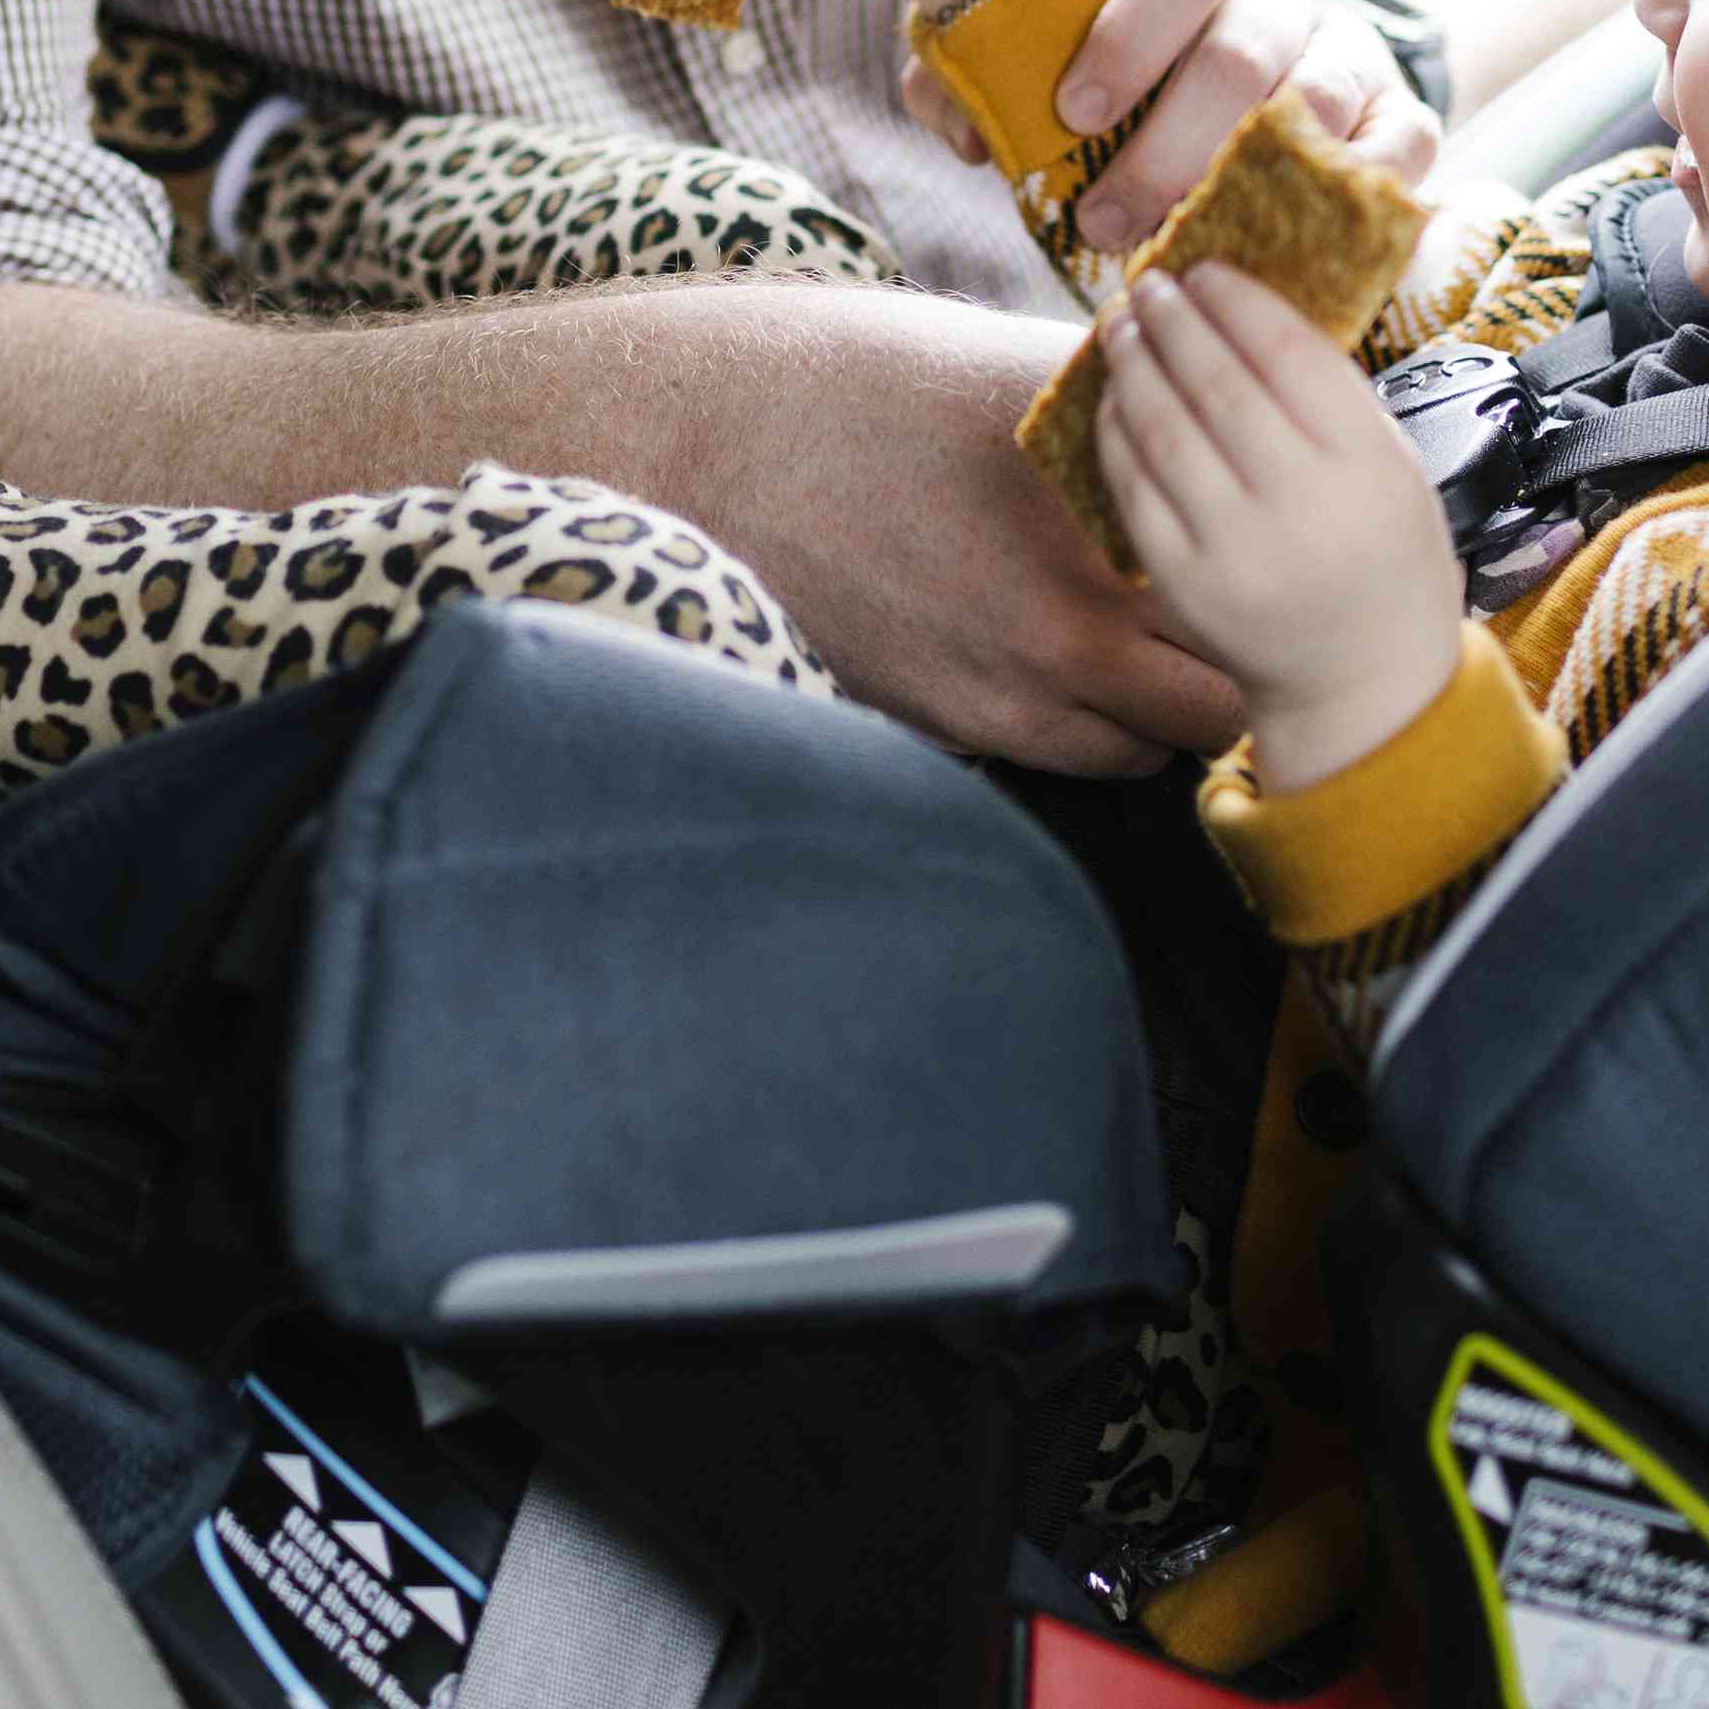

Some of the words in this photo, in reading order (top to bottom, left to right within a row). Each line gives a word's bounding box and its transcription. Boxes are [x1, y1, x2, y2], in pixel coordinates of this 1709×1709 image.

[209, 1505, 275, 1580] Vehicle
[263, 1567, 311, 1618] Seat
[302, 1604, 345, 1650] Belt
[336, 1639, 384, 1688] Path
[264, 1529, 327, 1593] LATCH
[317, 1582, 369, 1638] Strap
[362, 1628, 389, 1657] or
[277, 1504, 417, 1641] REAR-FACING
